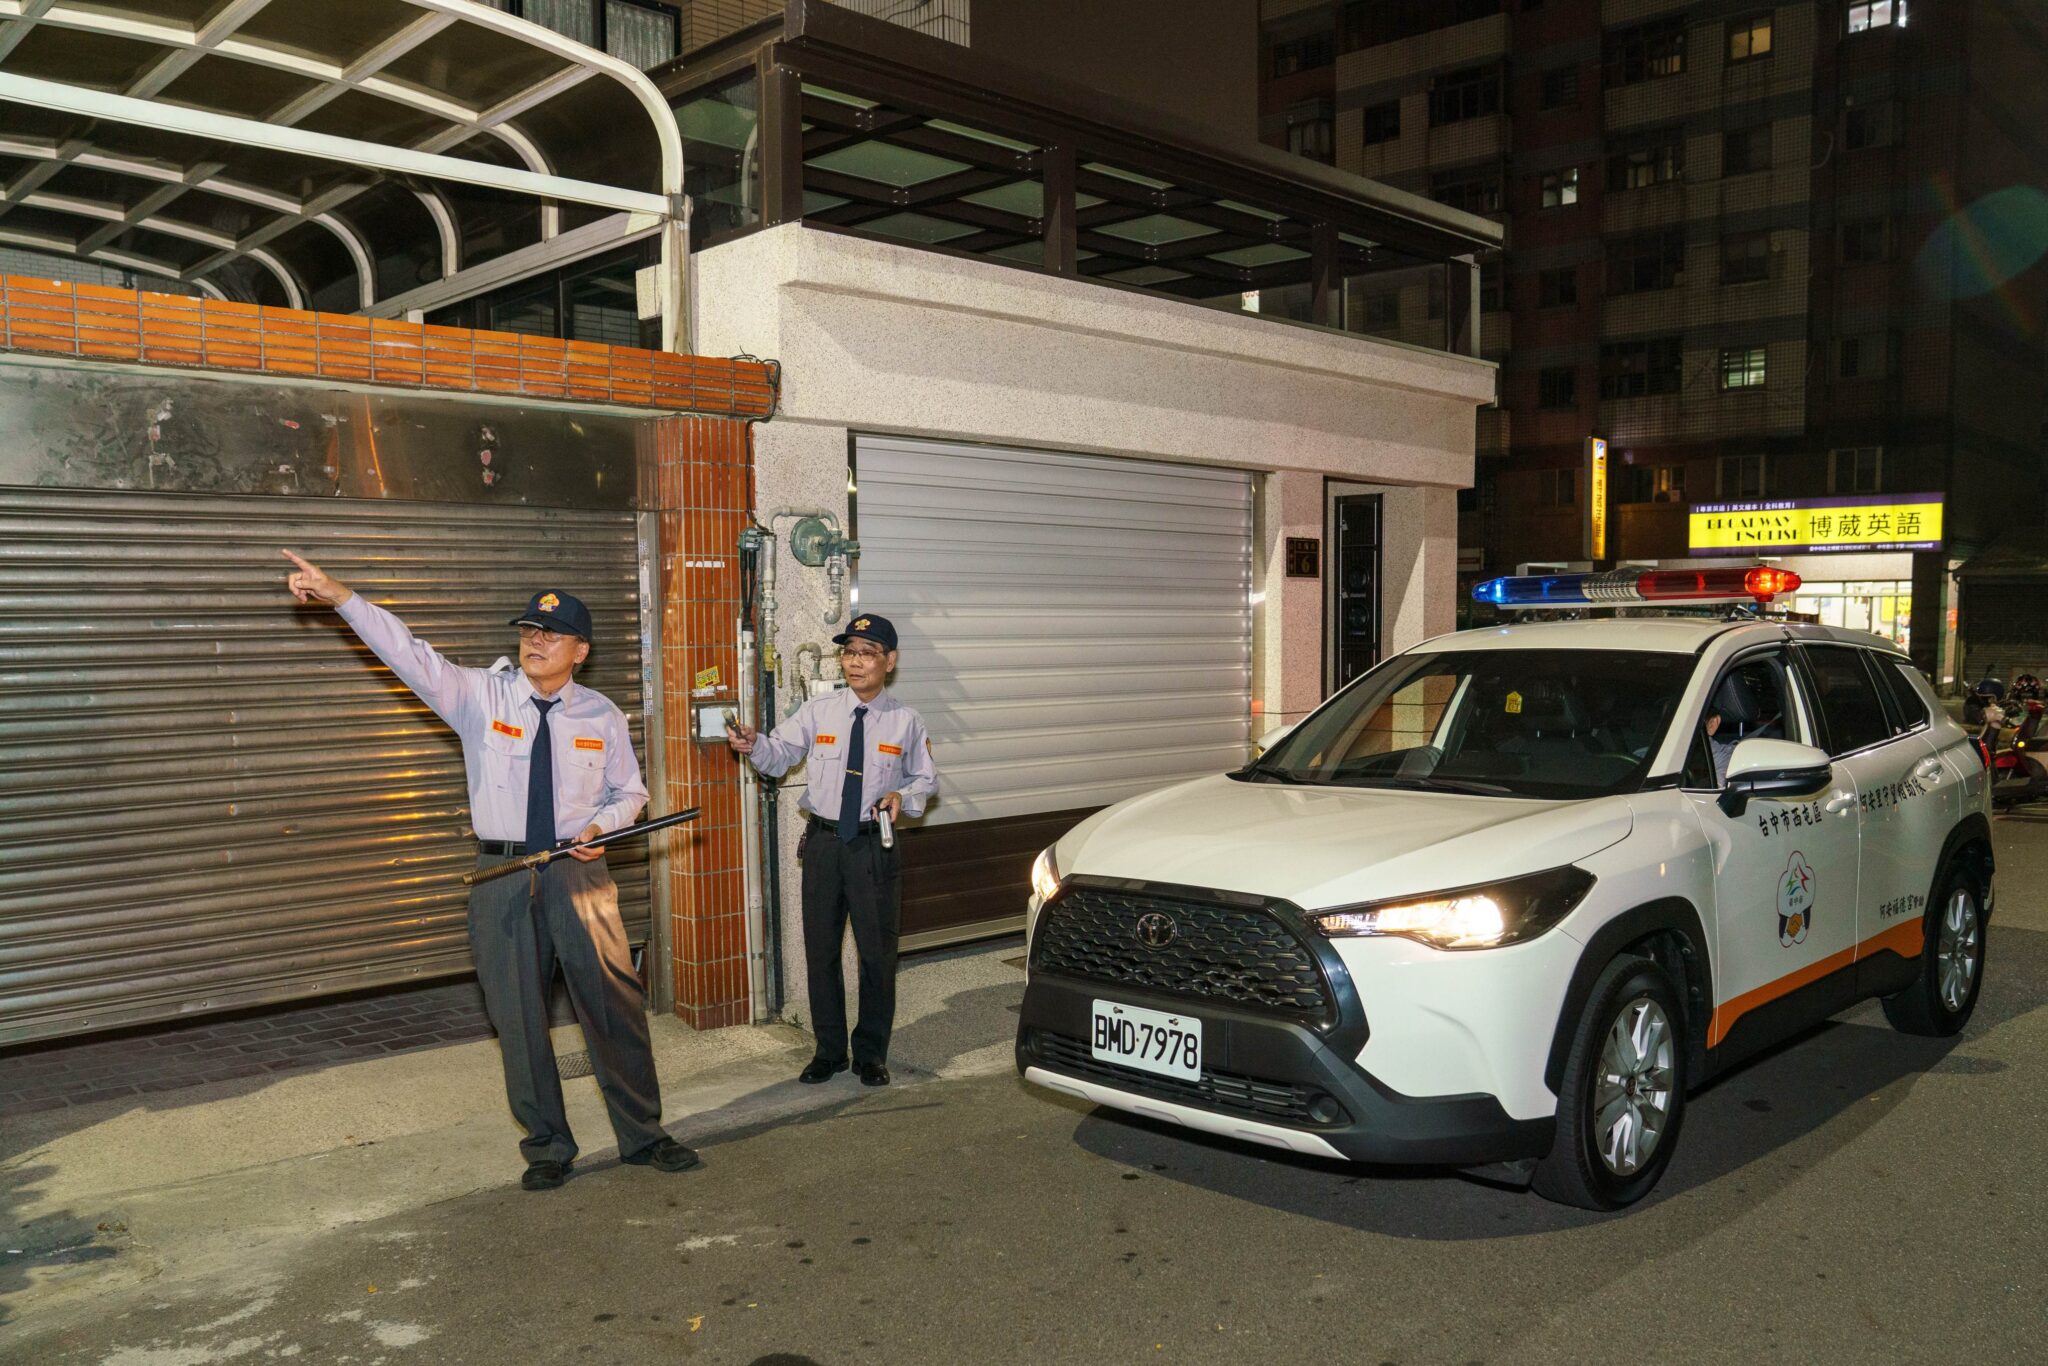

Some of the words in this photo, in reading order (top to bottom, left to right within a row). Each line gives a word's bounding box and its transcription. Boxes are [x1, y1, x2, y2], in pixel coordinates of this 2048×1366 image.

[1809, 512, 1921, 538] 博葳英語
[1759, 801, 1822, 837] 台中市西屯區
